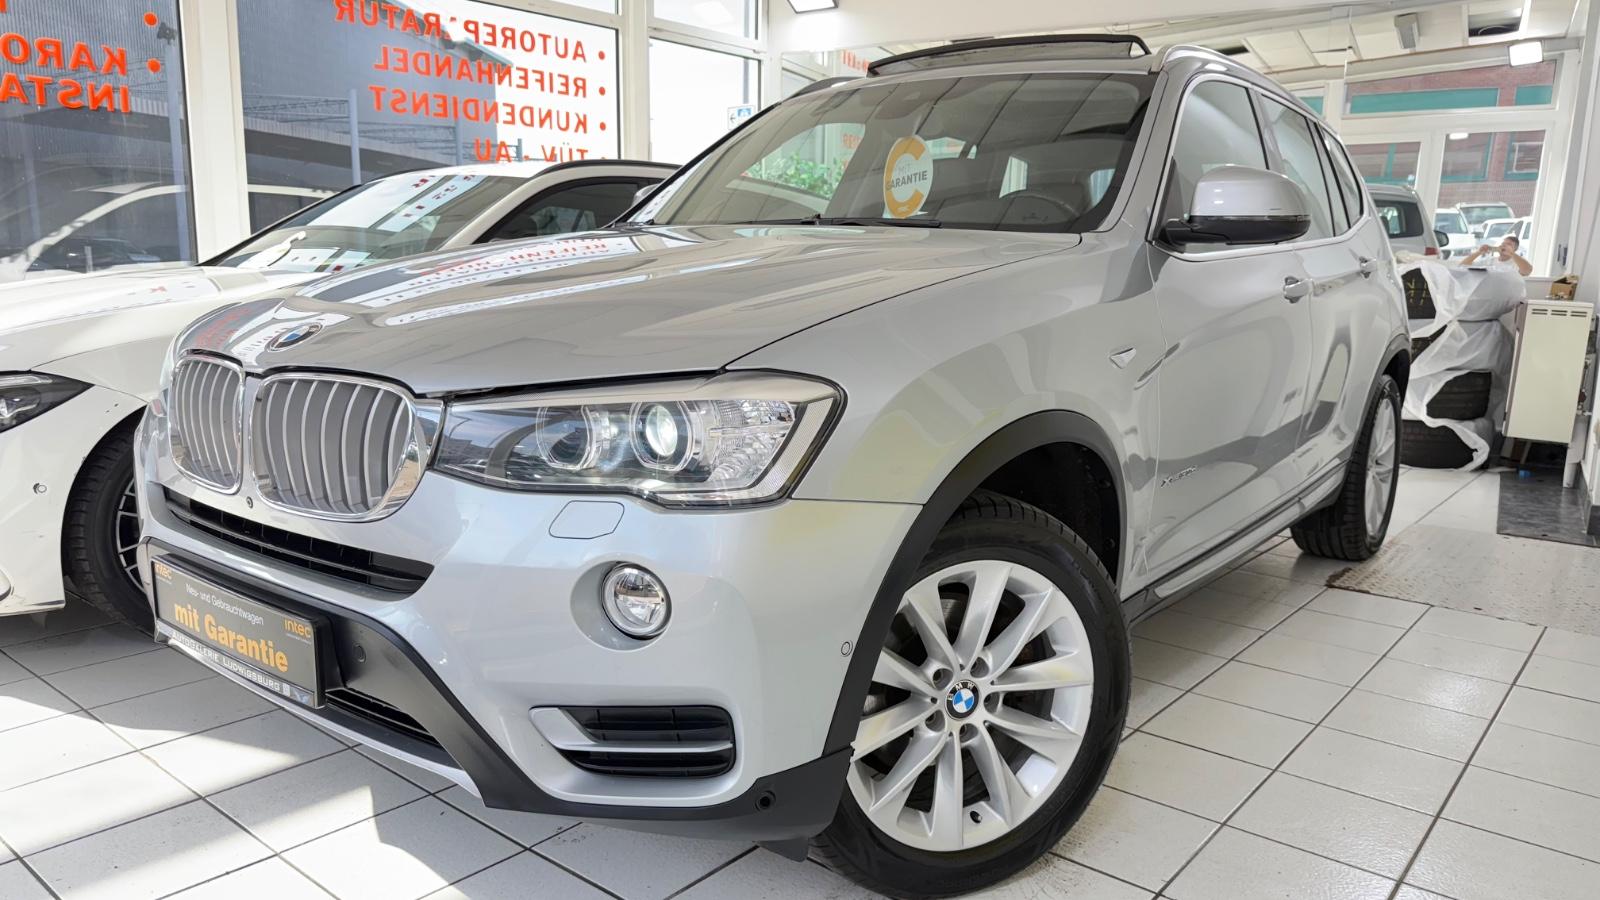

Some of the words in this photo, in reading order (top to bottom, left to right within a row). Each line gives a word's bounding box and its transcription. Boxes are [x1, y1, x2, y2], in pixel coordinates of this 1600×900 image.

[886, 170, 928, 191] GARANTIE
[212, 595, 264, 625] Gebrauchtwagen
[174, 603, 200, 632] mit
[204, 614, 288, 672] Garantie
